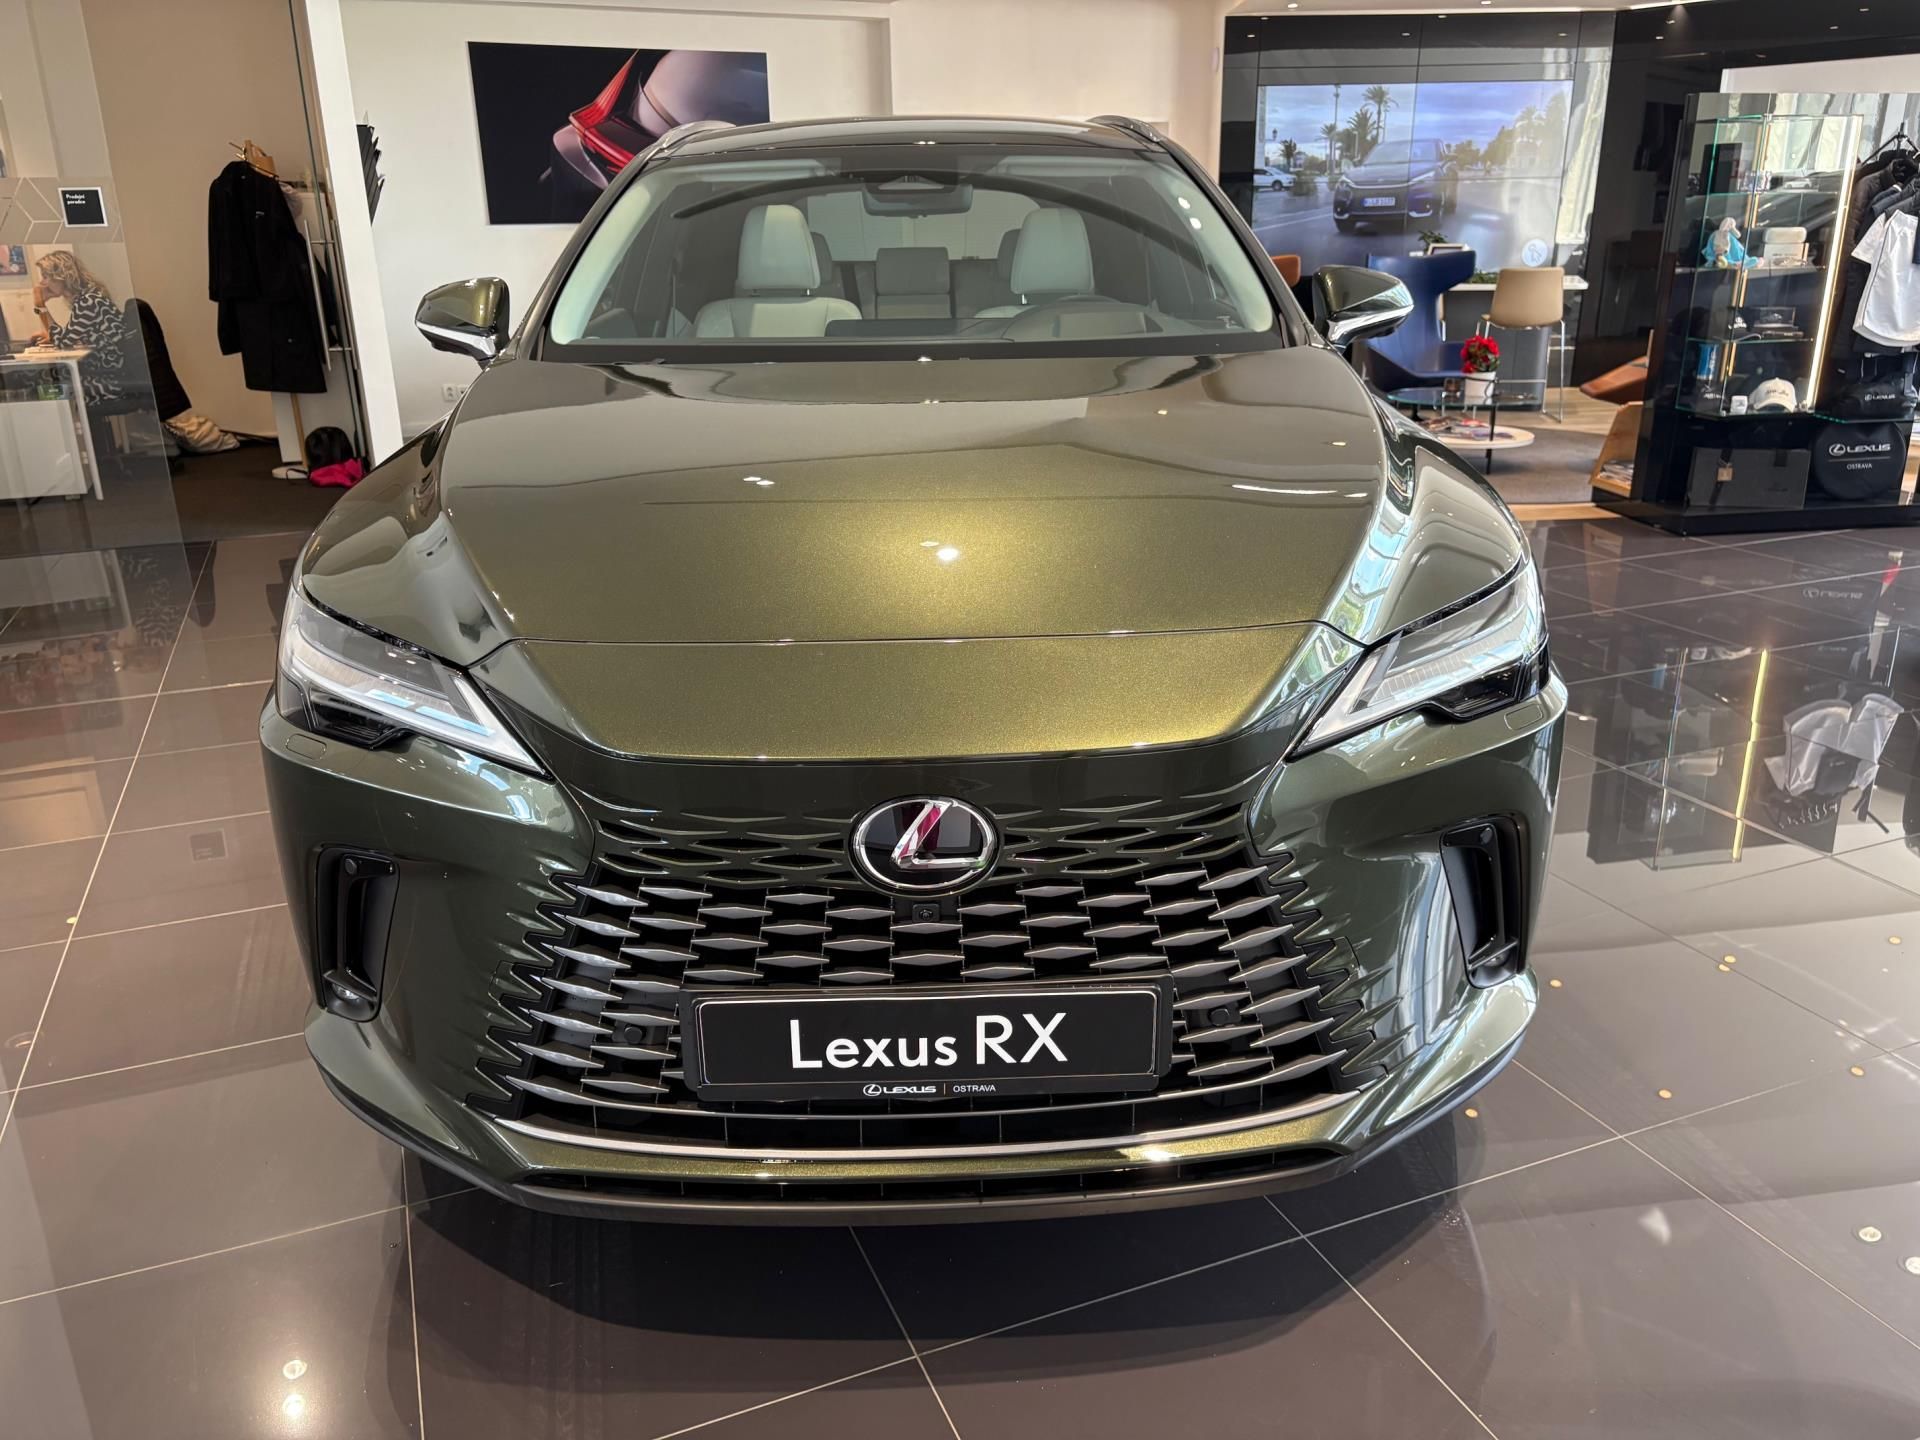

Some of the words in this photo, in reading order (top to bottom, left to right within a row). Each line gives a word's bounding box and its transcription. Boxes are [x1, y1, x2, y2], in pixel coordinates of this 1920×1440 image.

[1846, 443, 1891, 453] LEXUS
[790, 1019, 958, 1068] Lexus
[976, 1012, 1068, 1065] RX
[883, 1085, 937, 1094] LEXUS
[953, 1084, 996, 1093] OSTRAVA
